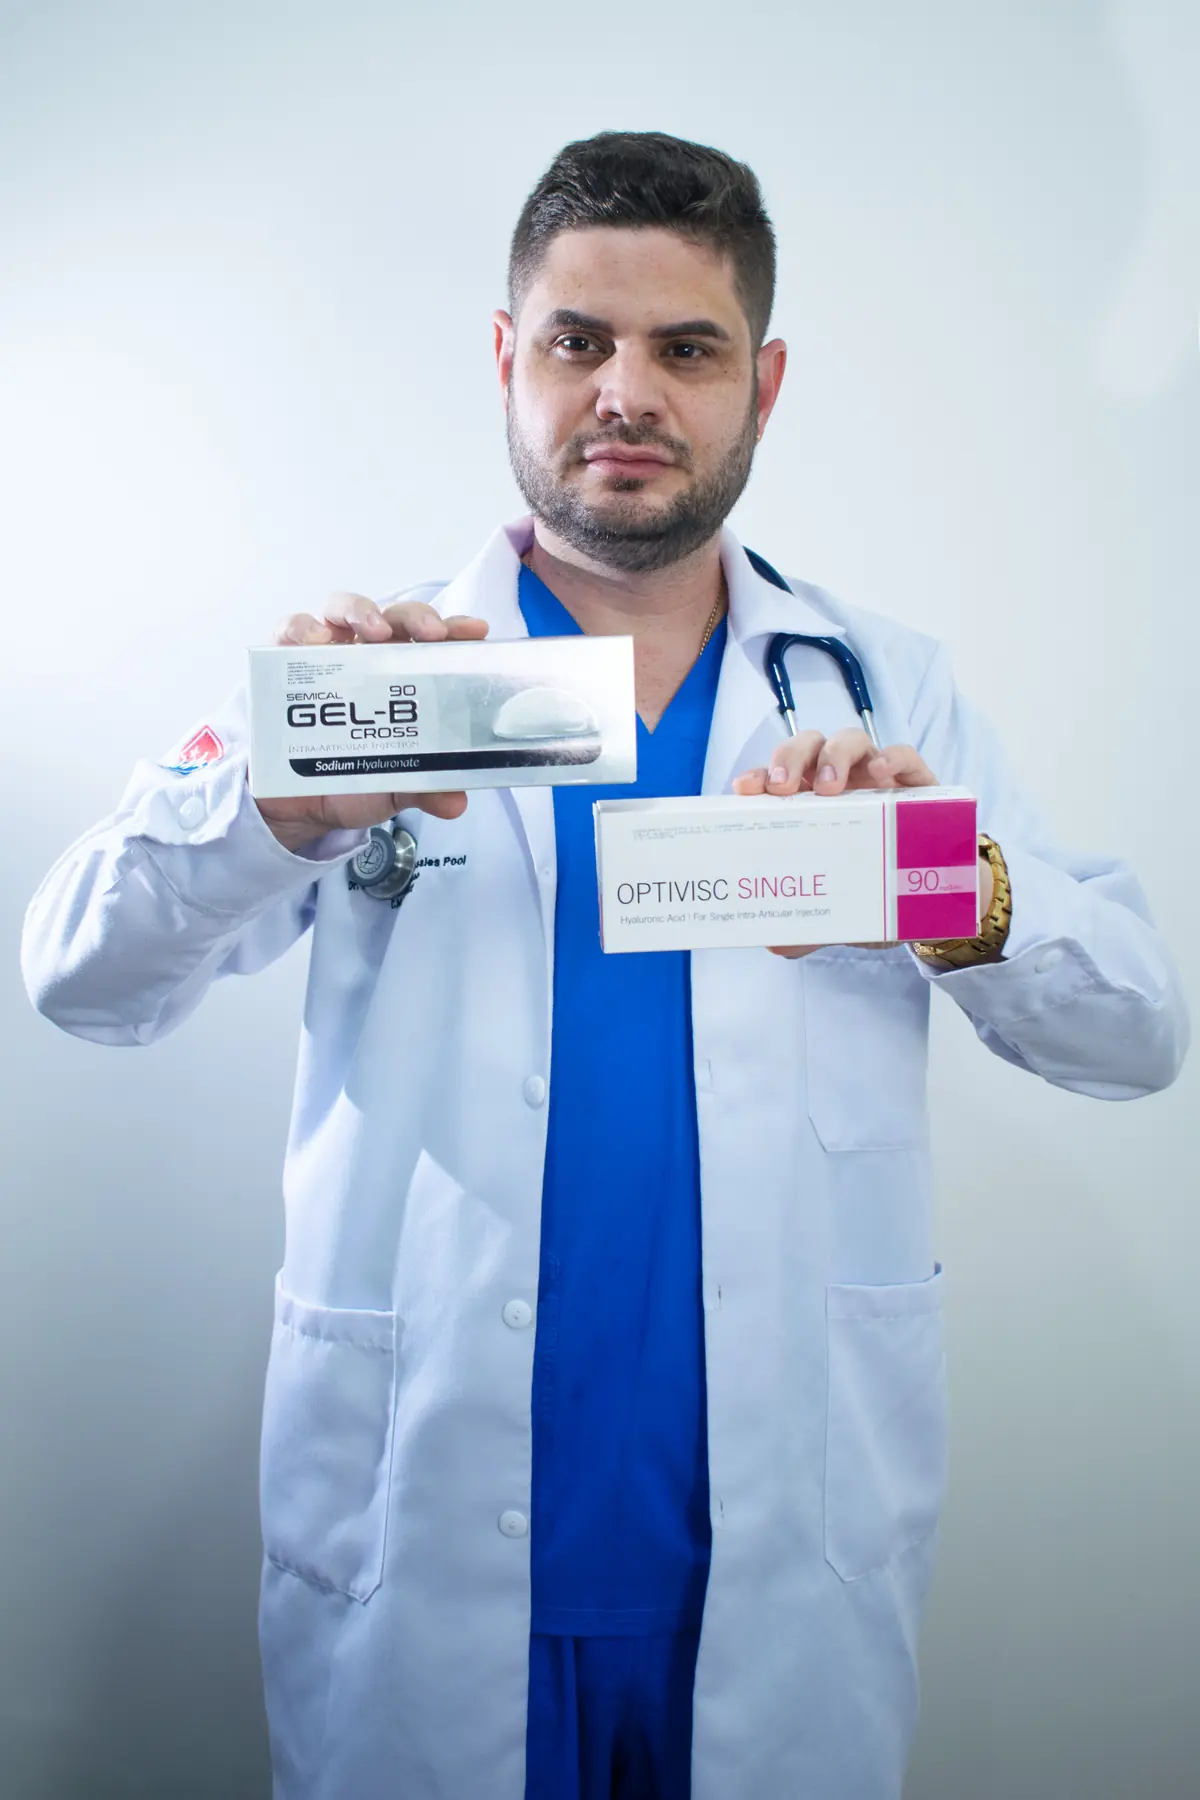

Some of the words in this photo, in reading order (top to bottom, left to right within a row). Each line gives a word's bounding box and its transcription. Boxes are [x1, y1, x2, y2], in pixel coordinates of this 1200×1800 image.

[286, 692, 343, 702] SEMICAL
[389, 684, 417, 697] 90
[287, 699, 418, 728] GEL-B
[350, 726, 419, 740] CROSS
[315, 760, 355, 772] Sodium
[356, 757, 420, 771] Hyaluronate
[442, 854, 467, 867] Pool
[907, 869, 939, 892] 90
[616, 879, 729, 905] OPTIVISC
[737, 874, 828, 900] SINGLE
[620, 913, 665, 925] Hyaluronic
[666, 912, 686, 923] Acid
[693, 911, 707, 922] For
[709, 910, 735, 922] Single
[737, 907, 793, 920] Intra-Articular
[795, 906, 831, 918] Injection
